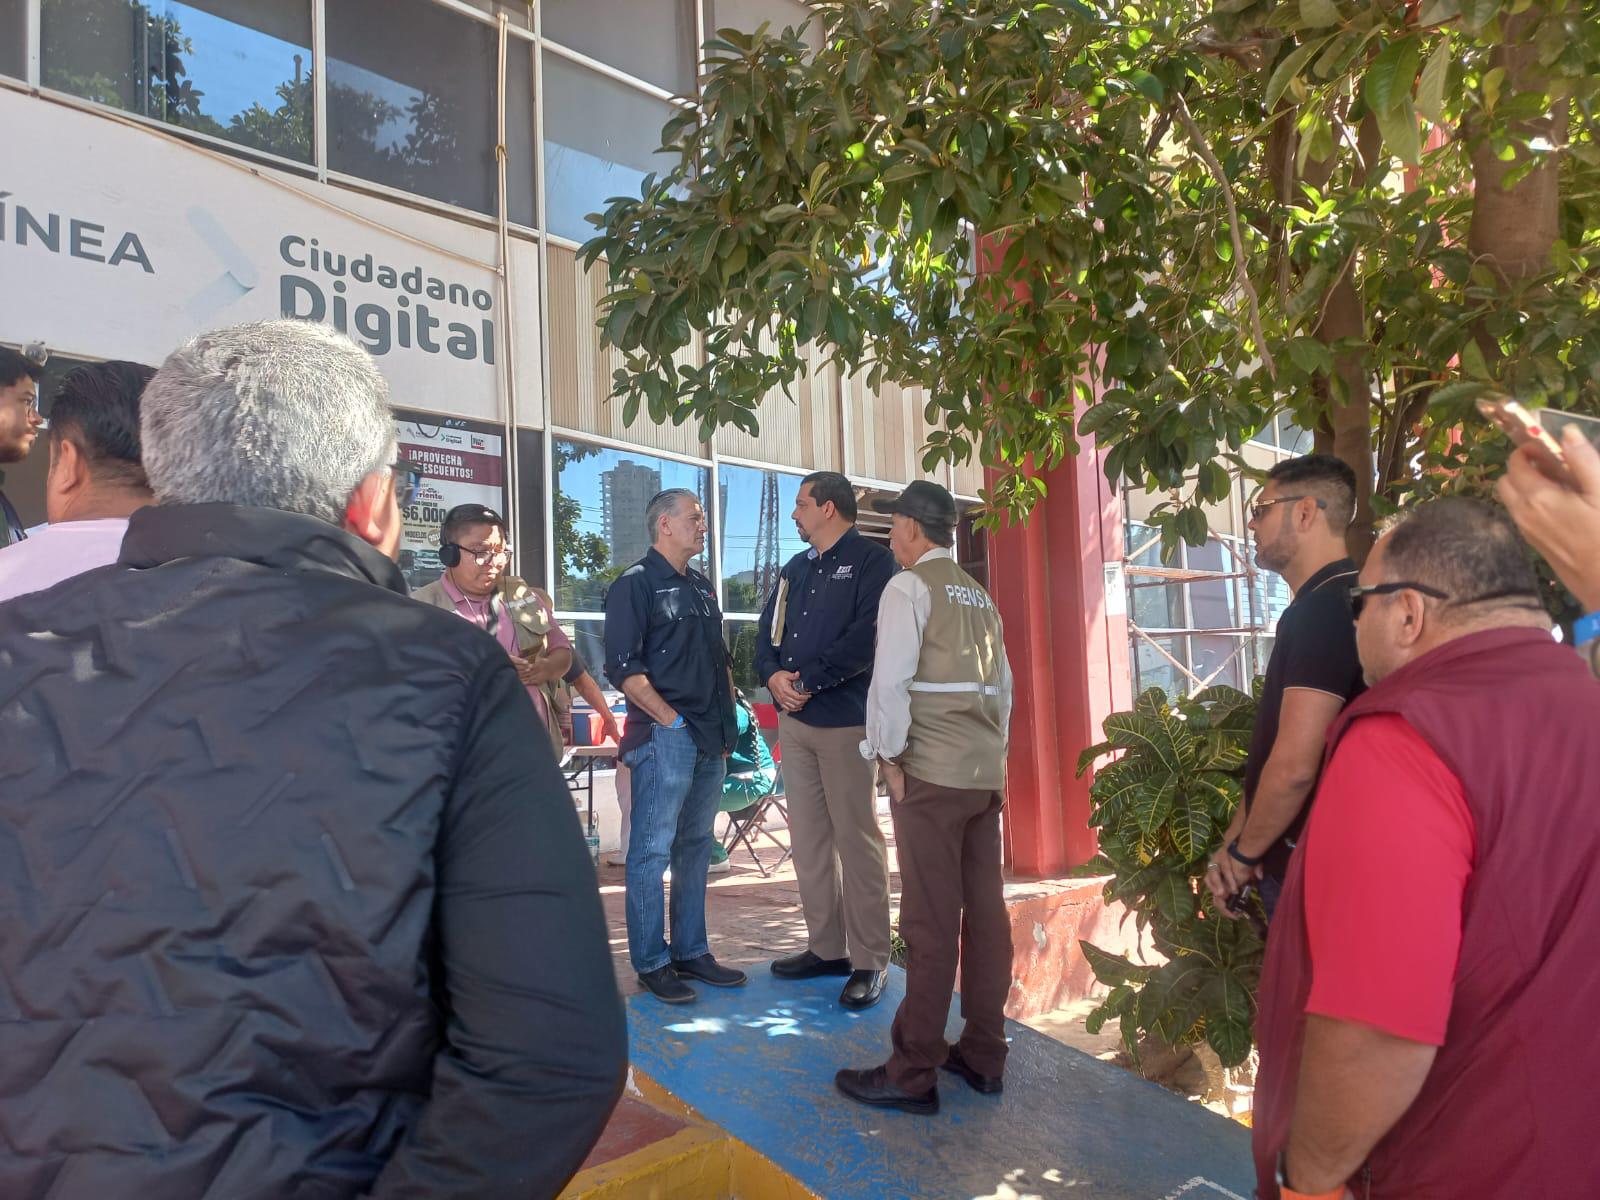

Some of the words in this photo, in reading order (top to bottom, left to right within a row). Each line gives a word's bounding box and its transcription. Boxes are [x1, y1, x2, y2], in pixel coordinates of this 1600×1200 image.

[280, 235, 493, 311] Ciudadano
[280, 274, 495, 365] Digital
[409, 450, 462, 466] ¡APROVECHA
[416, 462, 473, 479] ESCUENTOS!
[402, 505, 446, 523] $6,000
[944, 584, 994, 612] PRENSA
